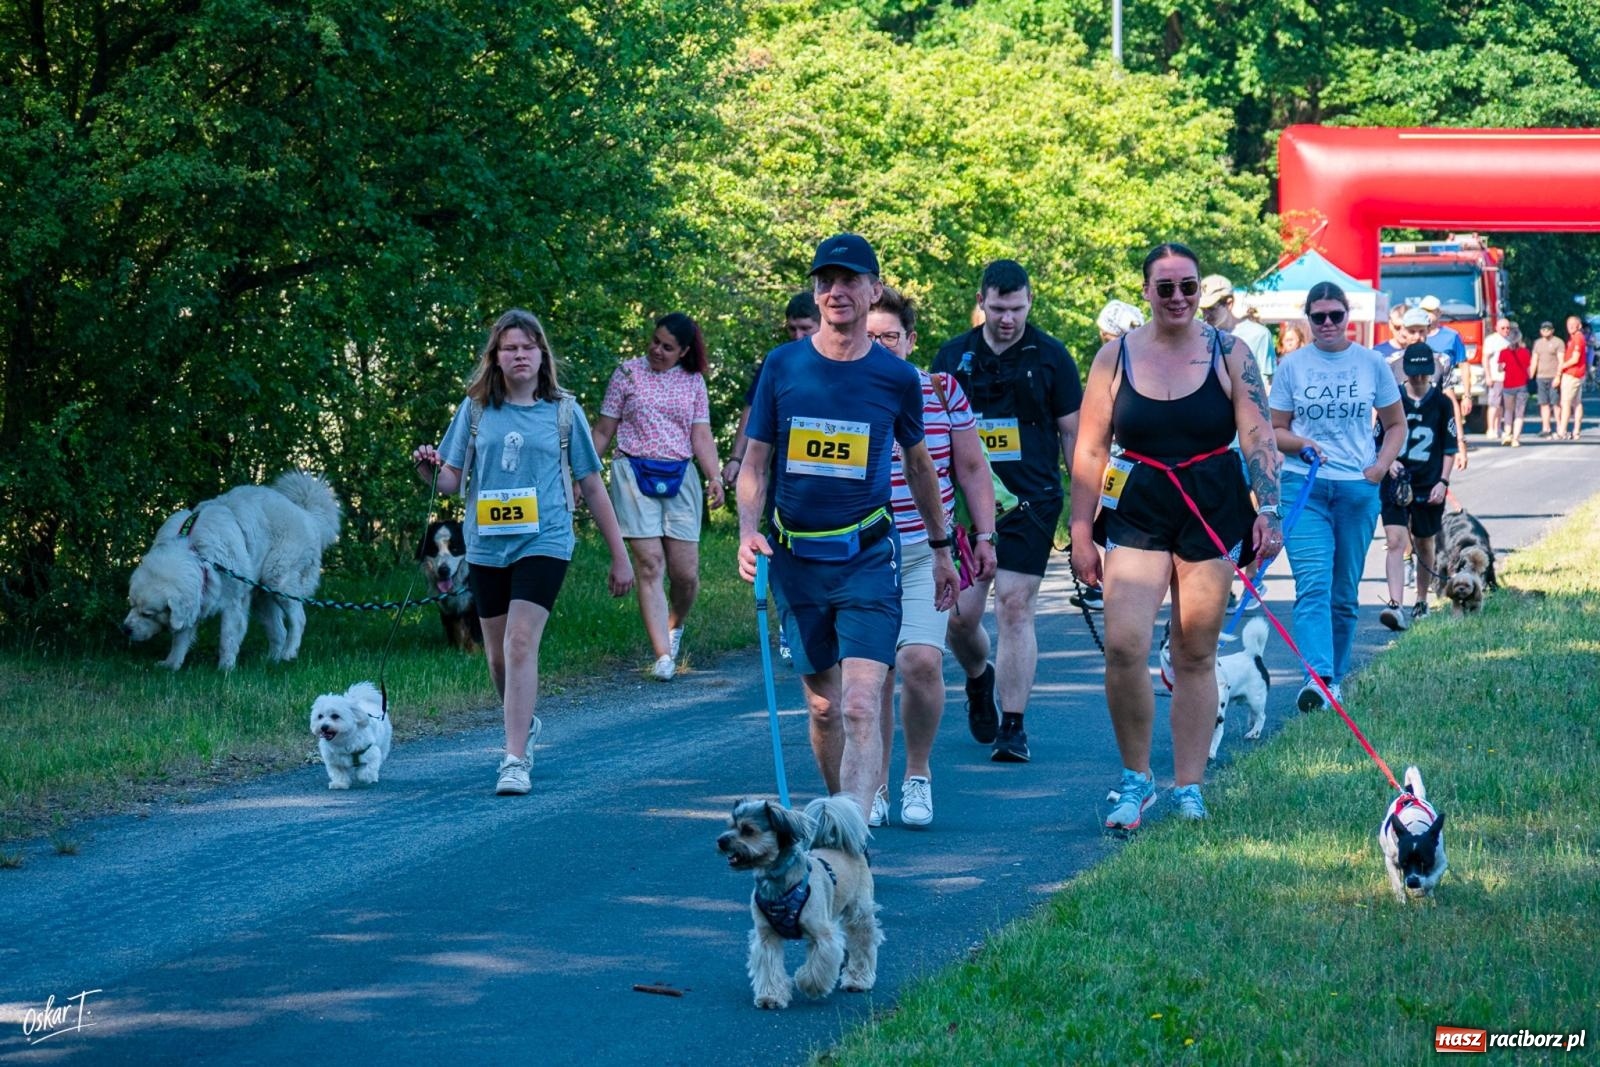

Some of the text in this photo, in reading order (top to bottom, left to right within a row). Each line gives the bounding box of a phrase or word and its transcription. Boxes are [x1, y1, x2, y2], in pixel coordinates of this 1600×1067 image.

[1304, 380, 1359, 399] CAFÉ
[1297, 399, 1367, 420] POÉSIE
[806, 439, 851, 460] 025
[1103, 475, 1115, 491] 5
[490, 506, 524, 521] 023
